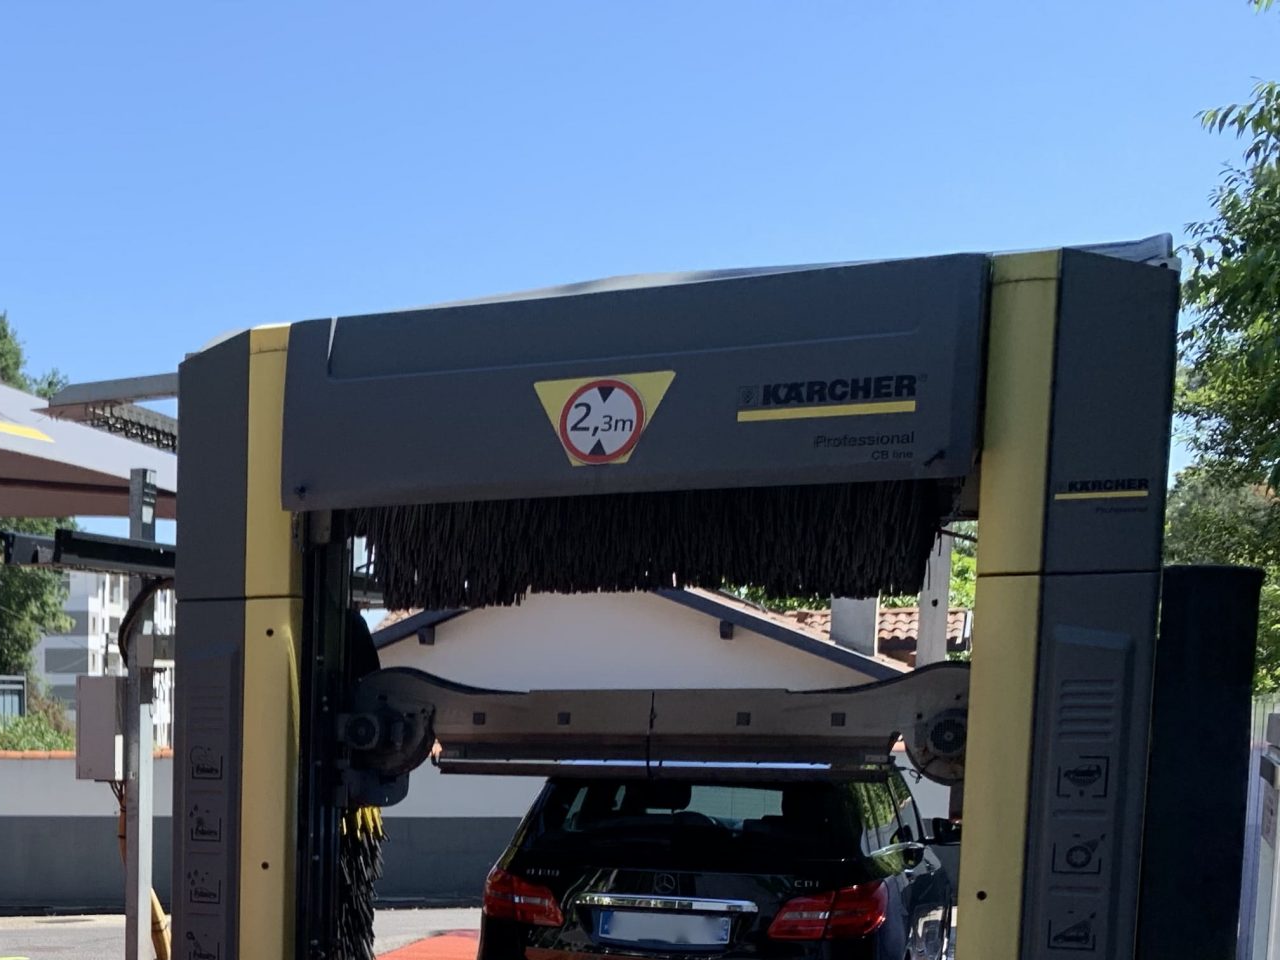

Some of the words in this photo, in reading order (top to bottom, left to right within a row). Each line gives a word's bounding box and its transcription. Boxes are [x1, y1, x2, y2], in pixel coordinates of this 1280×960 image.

[762, 375, 918, 406] KÄRCHER
[570, 402, 634, 436] 2,3m
[814, 431, 915, 449] Professional
